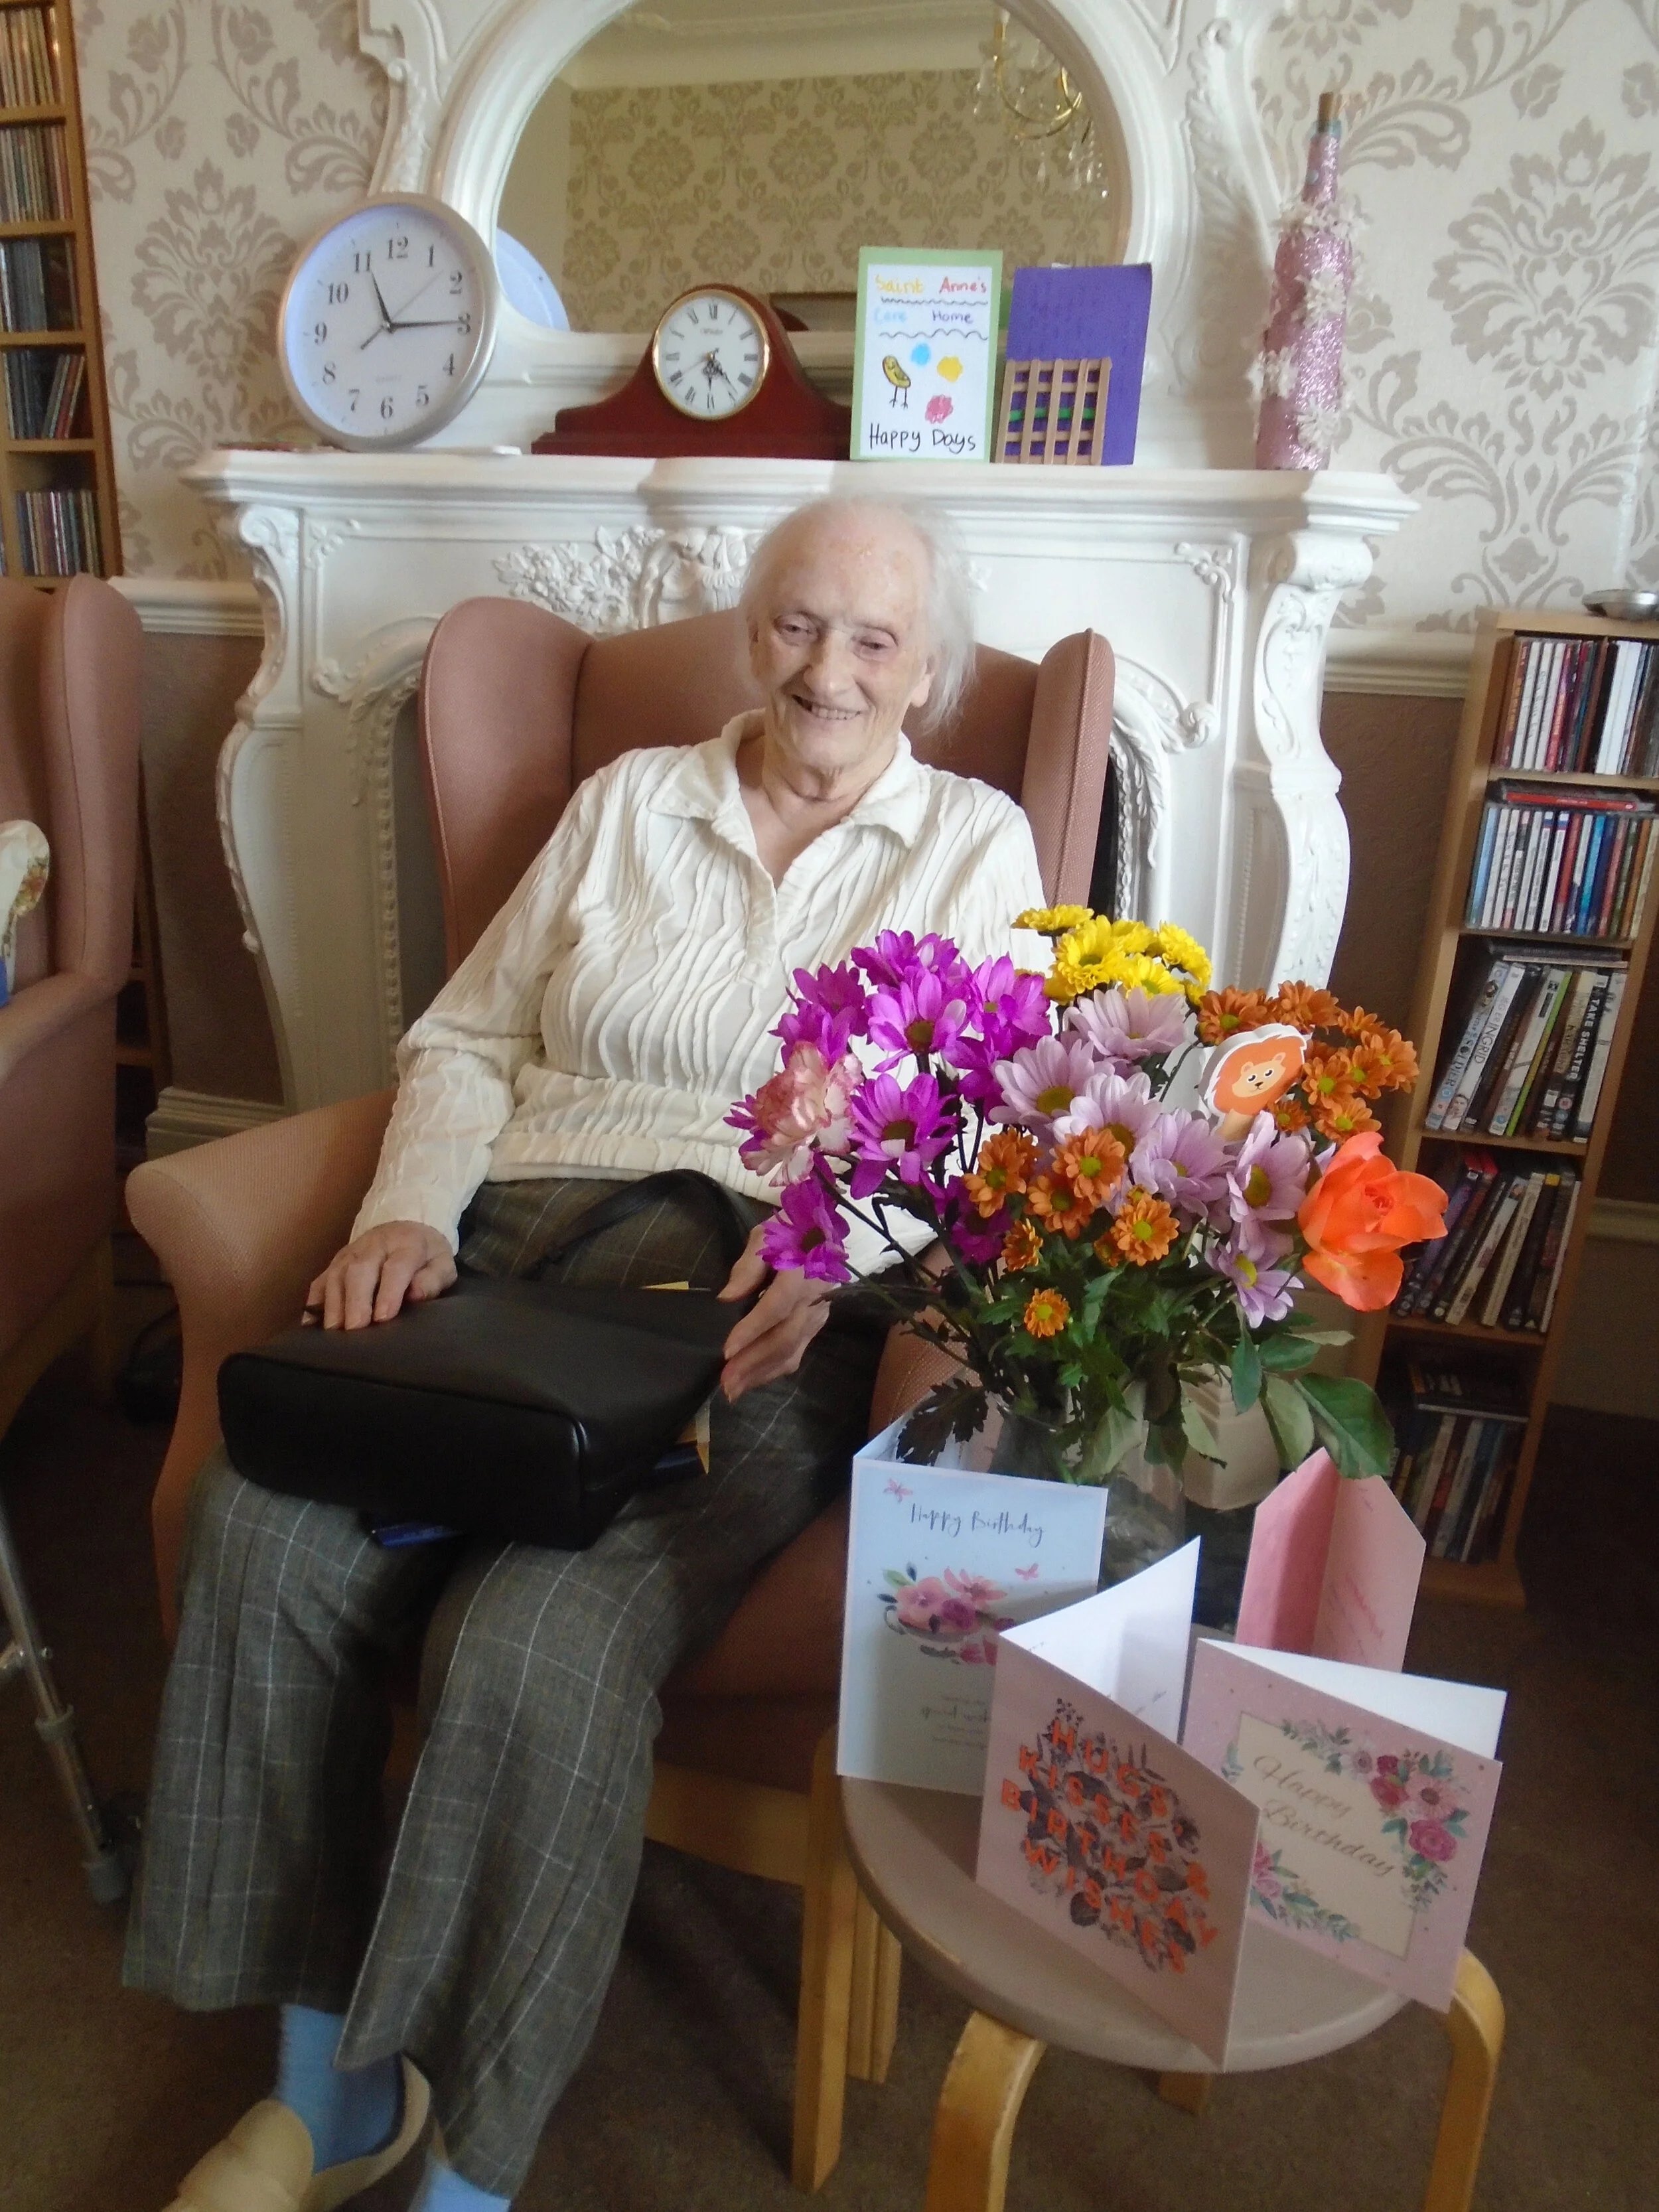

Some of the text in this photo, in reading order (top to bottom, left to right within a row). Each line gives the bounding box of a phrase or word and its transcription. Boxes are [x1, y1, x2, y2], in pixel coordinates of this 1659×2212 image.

[386, 236, 409, 259] 12
[353, 250, 372, 273] 11
[327, 281, 349, 305] 10
[449, 271, 463, 295] 2
[875, 273, 923, 295] Saint
[457, 312, 470, 336] 3
[932, 309, 974, 324] Home
[314, 322, 328, 345] 9
[322, 360, 336, 385] 8
[443, 352, 455, 377] 4
[348, 388, 360, 411] 7
[380, 396, 394, 419] 6
[415, 384, 430, 407] 5
[869, 421, 976, 455] Happy Days
[1474, 1022, 1498, 1065] INGRID
[1571, 998, 1600, 1080] TAKE SHELTER
[911, 1503, 1044, 1548] Happy Birthday
[1051, 1719, 1168, 1817] HUGS
[1253, 1755, 1352, 1818] Happy
[1262, 1799, 1395, 1877] Birthday
